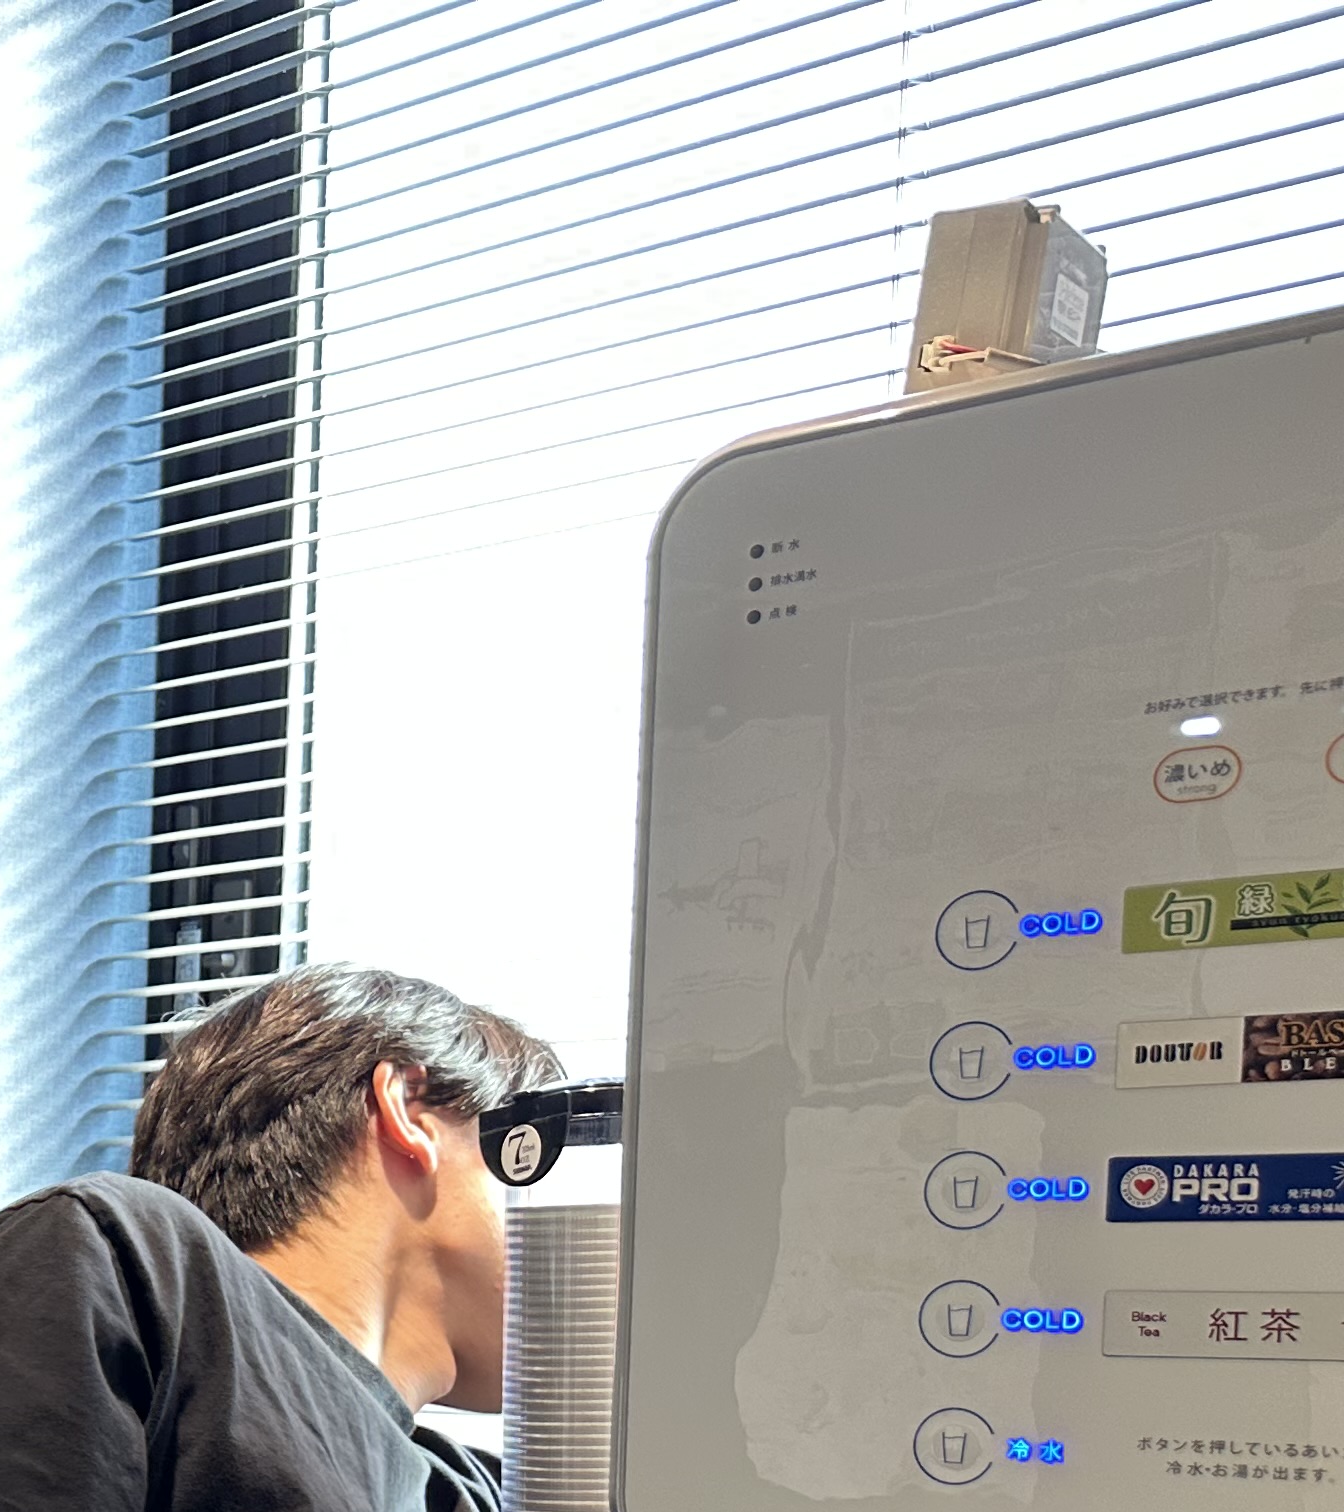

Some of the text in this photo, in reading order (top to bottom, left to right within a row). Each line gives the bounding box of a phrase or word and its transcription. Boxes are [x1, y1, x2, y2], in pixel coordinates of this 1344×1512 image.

[1164, 758, 1232, 784] 濃いめ
[1237, 884, 1275, 917] 緑
[1019, 909, 1104, 938] COLD
[1153, 891, 1214, 945] 旬
[1013, 1043, 1097, 1071] COLD
[1134, 1041, 1223, 1064] DOUTOR
[508, 1130, 527, 1165] 7
[1173, 1163, 1260, 1178] DAKARA
[1007, 1177, 1090, 1201] COLD
[1171, 1177, 1260, 1203] PRO
[1001, 1308, 1084, 1333] COLD
[1131, 1311, 1167, 1322] Black
[1208, 1308, 1301, 1343] 紅茶
[1138, 1325, 1160, 1337] Tea
[1006, 1437, 1065, 1464] 冷水
[1136, 1437, 1344, 1459] ボタンを押しているあい
